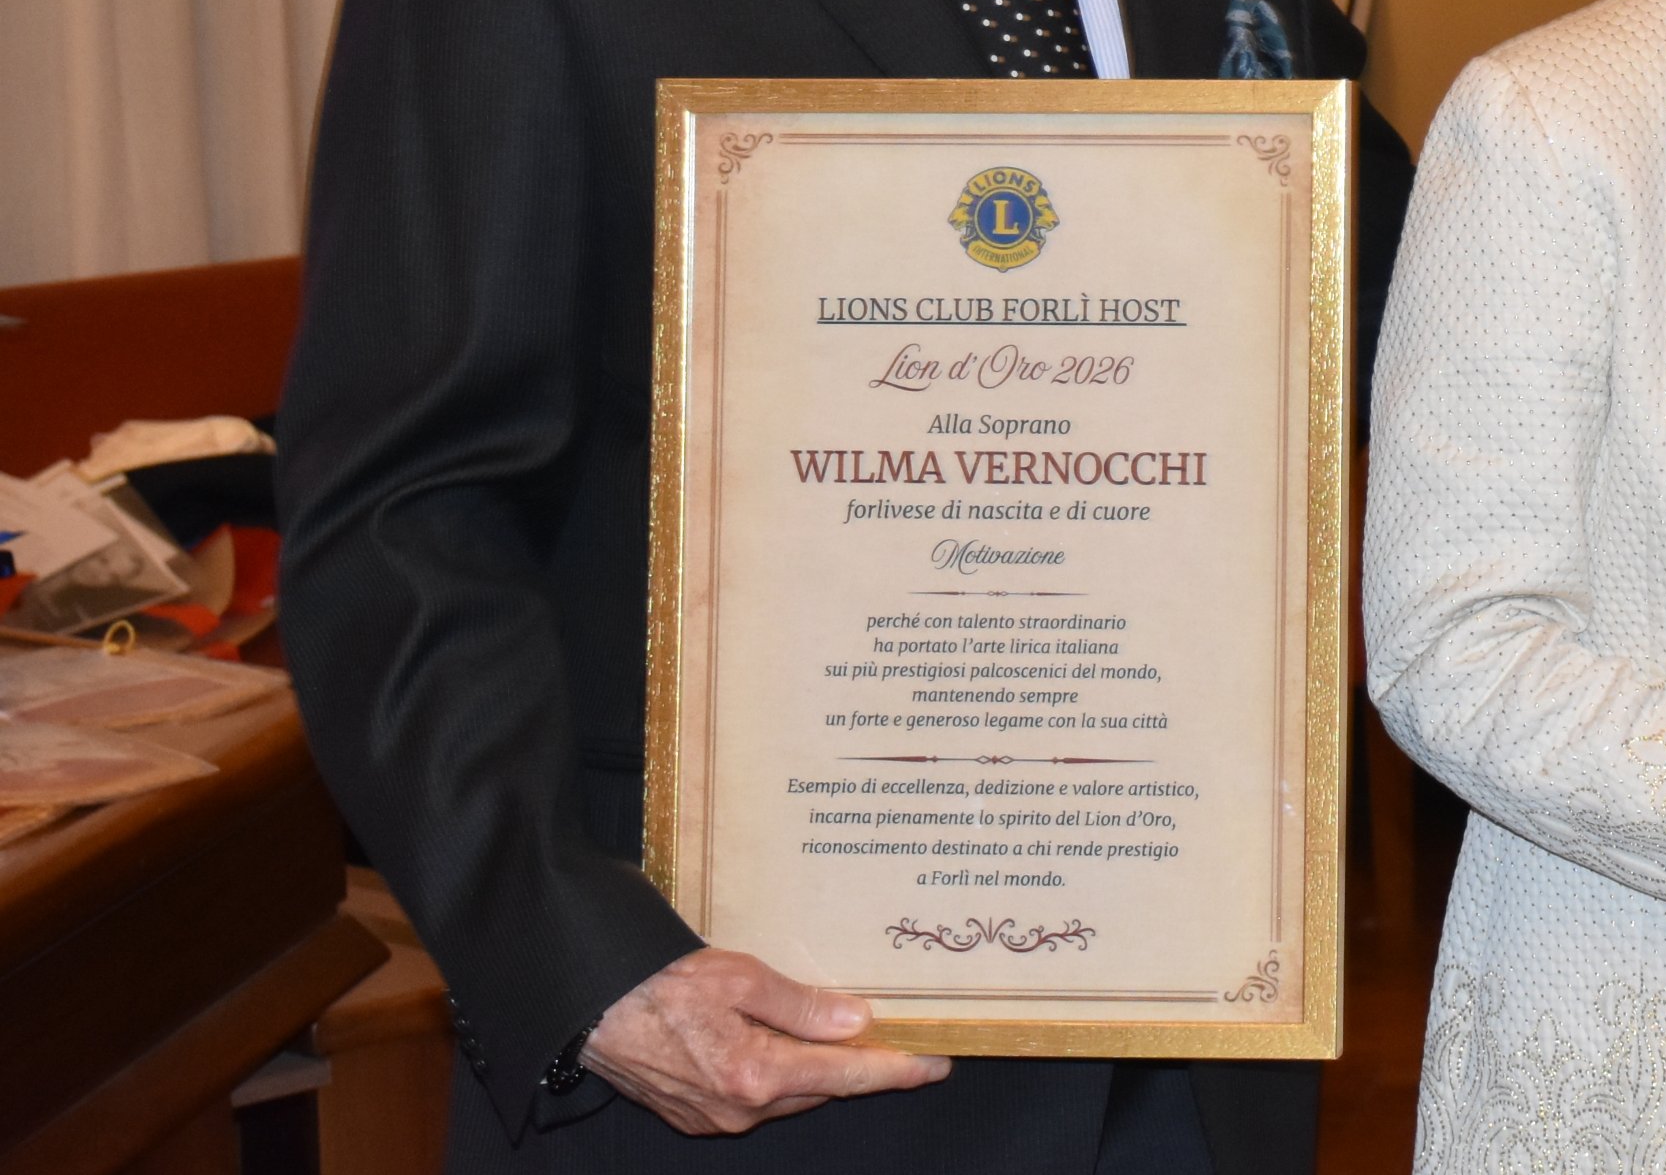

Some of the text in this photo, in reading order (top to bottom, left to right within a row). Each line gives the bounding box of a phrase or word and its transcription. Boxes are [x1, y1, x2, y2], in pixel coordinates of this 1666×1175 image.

[973, 171, 1036, 193] LIONS
[992, 199, 1020, 235] L
[973, 244, 1034, 264] INTERNATIONAL
[818, 292, 1181, 322] LIONS CLUB FORLÌ HOST
[868, 343, 1136, 392] Lion d'Oro 2026
[926, 413, 1072, 441] Alla Soprano
[789, 449, 1208, 486] WILMA VERNOCCHI
[842, 498, 1151, 525] forlivese di nascita e di cuore
[931, 538, 1065, 576] Motivazione
[866, 612, 1127, 633] perché con talento straordinario
[873, 636, 1119, 657] ha portato l'arte lirica italiana
[824, 660, 1162, 682] sui più prestigiosi palcoscenici del mondo,
[912, 687, 1079, 707] mantenendo sempre
[825, 710, 1168, 732] un forte e generoso legame con la sua città
[787, 777, 1199, 800] Esempio di eccellenza, dedizione e valore artistico,
[809, 808, 1176, 830] incarna pienamente lo spirito del Lion d'Oro,
[801, 838, 1179, 861] riconoscimento destinato a chi rende prestigio
[916, 869, 1066, 887] a Forlì nel mondo.
